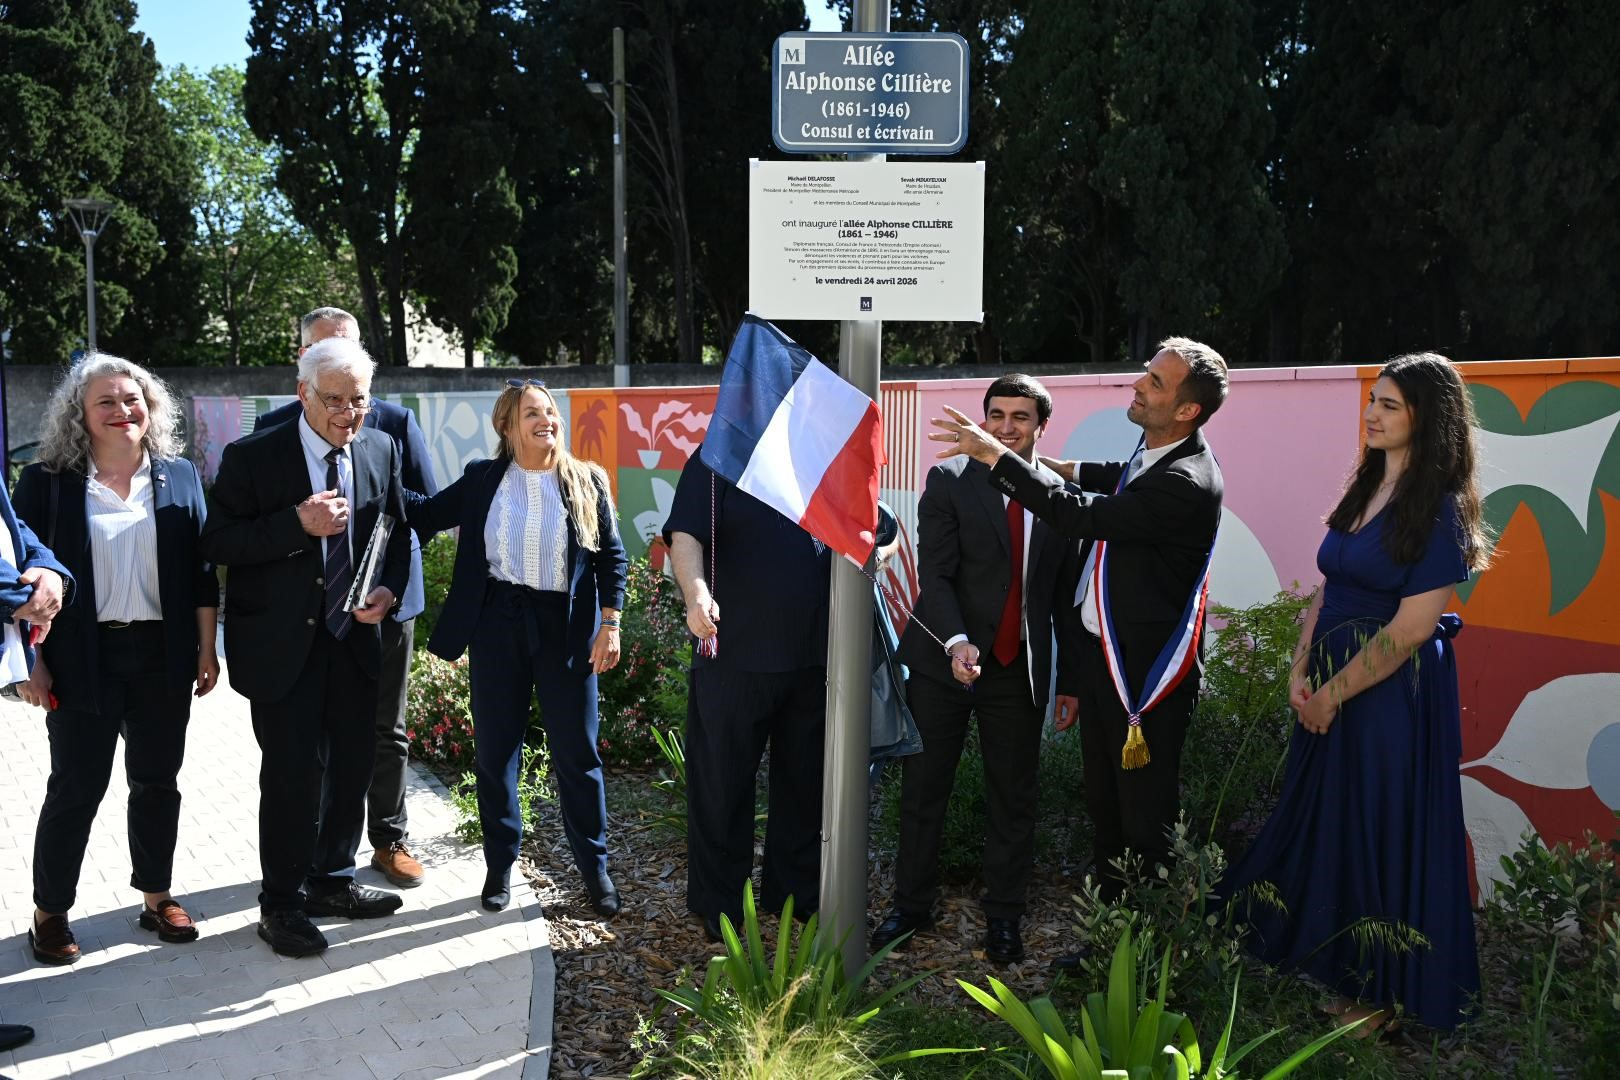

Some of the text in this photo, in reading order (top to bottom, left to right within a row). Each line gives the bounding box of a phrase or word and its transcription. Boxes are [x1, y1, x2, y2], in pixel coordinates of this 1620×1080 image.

[785, 48, 800, 62] M
[843, 44, 895, 66] Allée
[785, 71, 952, 94] Alphonse Cillière
[822, 100, 910, 120] (1861-1946)
[802, 123, 934, 140] Consul et écrivain
[799, 219, 837, 229] inauguré
[867, 220, 910, 229] Alphonse
[912, 219, 953, 228] CILLIÈRE
[838, 230, 862, 238] (1861
[874, 231, 898, 239] 1946)
